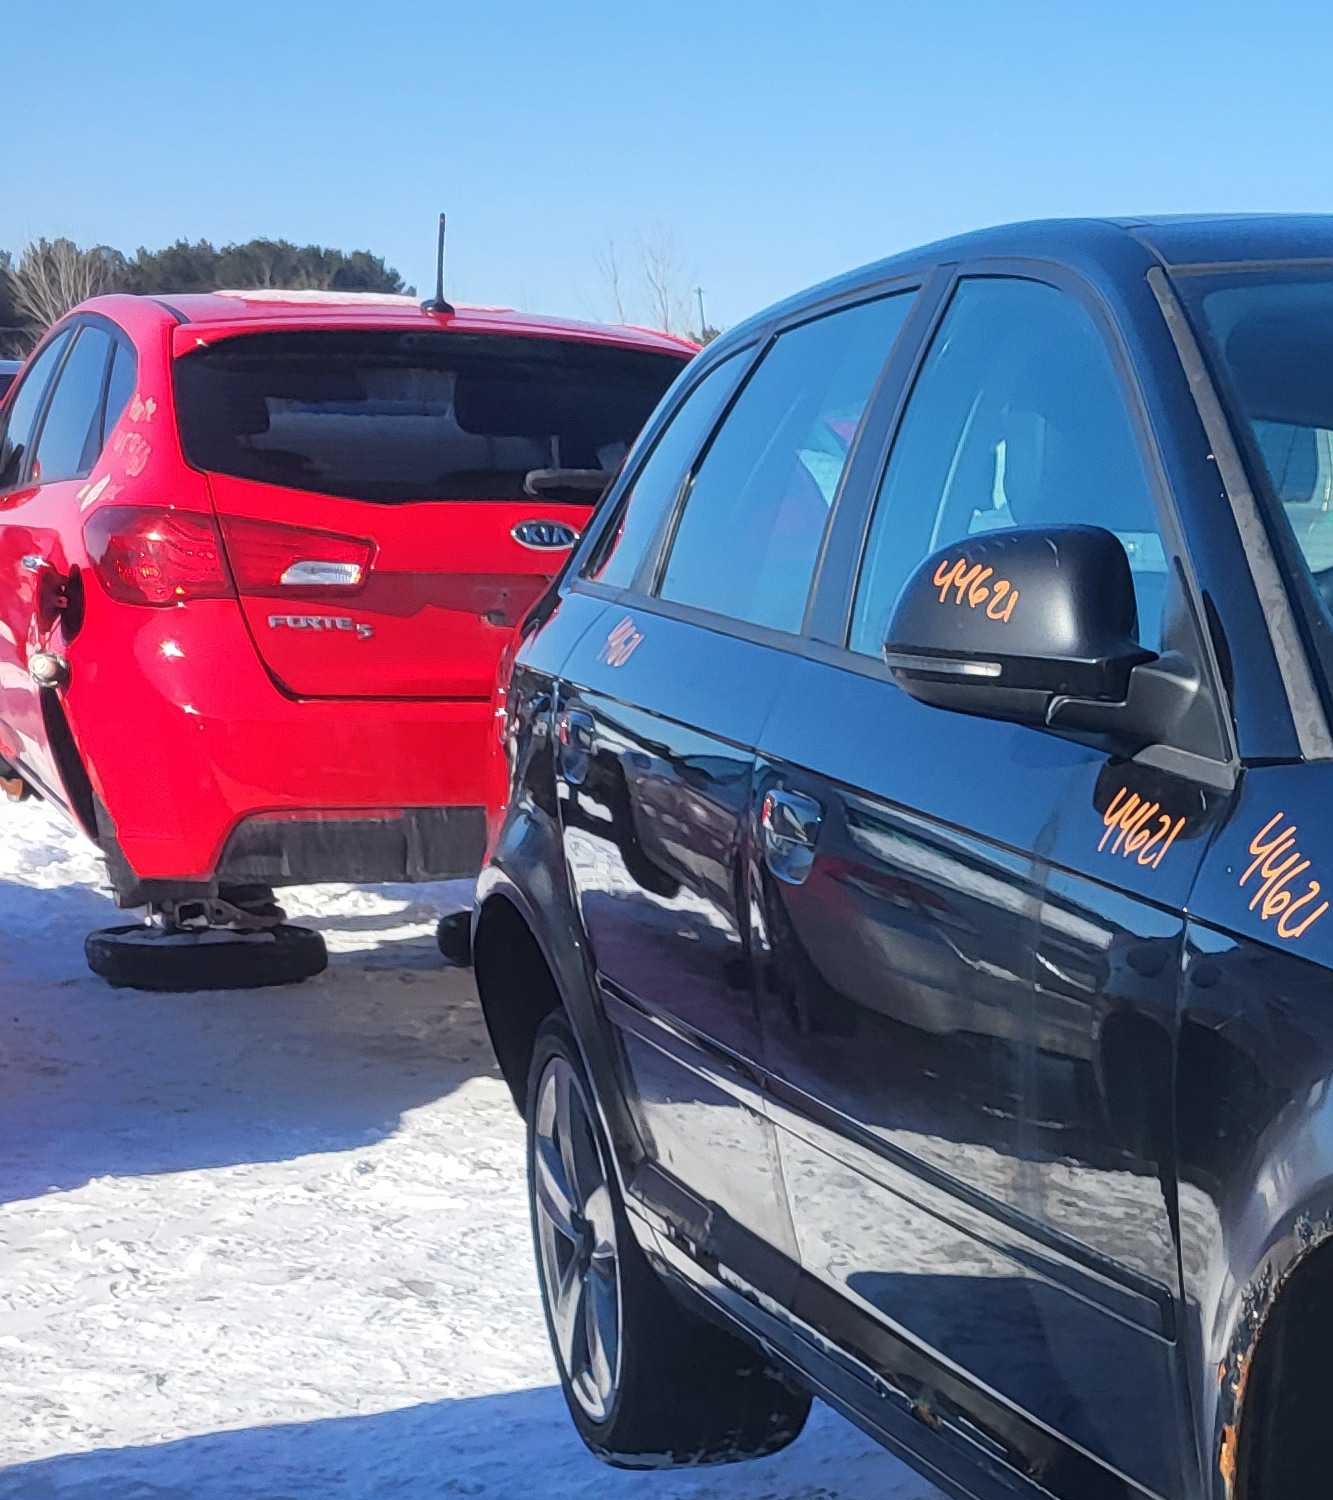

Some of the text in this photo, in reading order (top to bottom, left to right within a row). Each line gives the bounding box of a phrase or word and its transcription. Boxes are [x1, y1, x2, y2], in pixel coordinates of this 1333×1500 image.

[521, 525, 570, 545] KIA
[932, 559, 1018, 622] 44621
[1097, 787, 1186, 868] 44621
[1239, 811, 1329, 939] 44621
